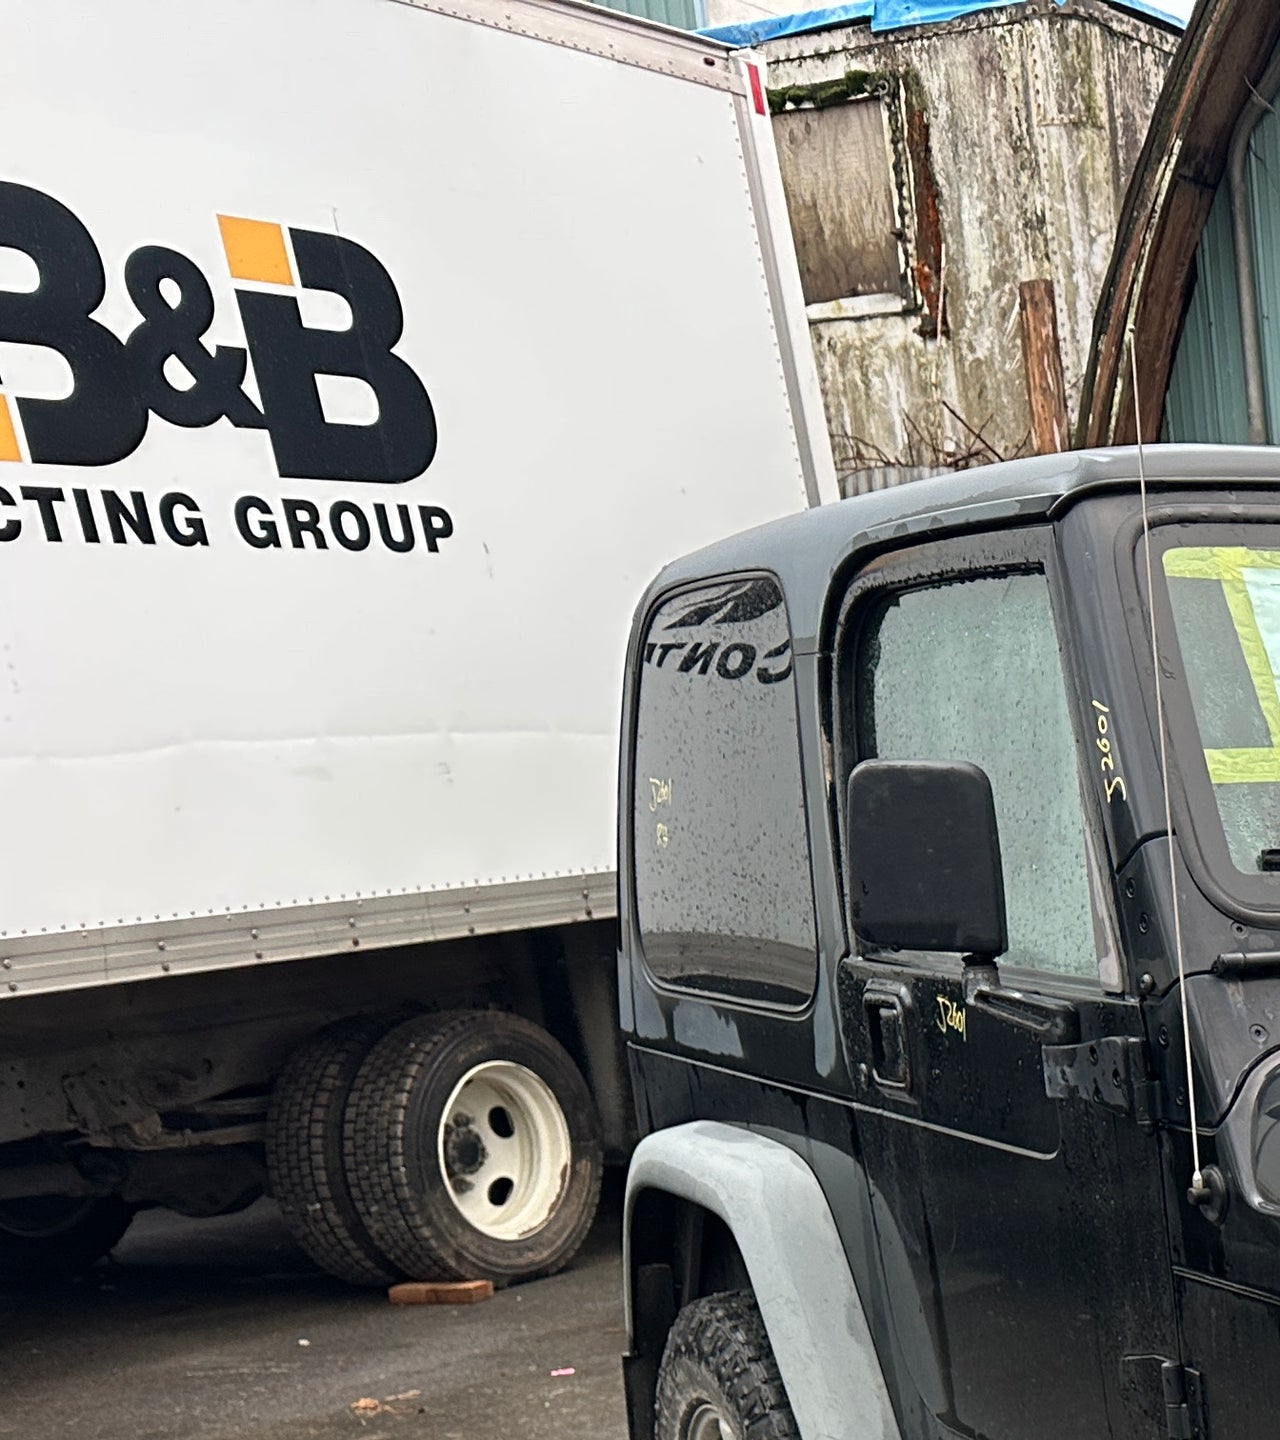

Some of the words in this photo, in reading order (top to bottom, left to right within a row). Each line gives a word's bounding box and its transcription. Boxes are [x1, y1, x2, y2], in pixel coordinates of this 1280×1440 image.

[0, 180, 438, 485] B&B
[233, 494, 455, 555] GROUP
[1091, 699, 1127, 804] J2601
